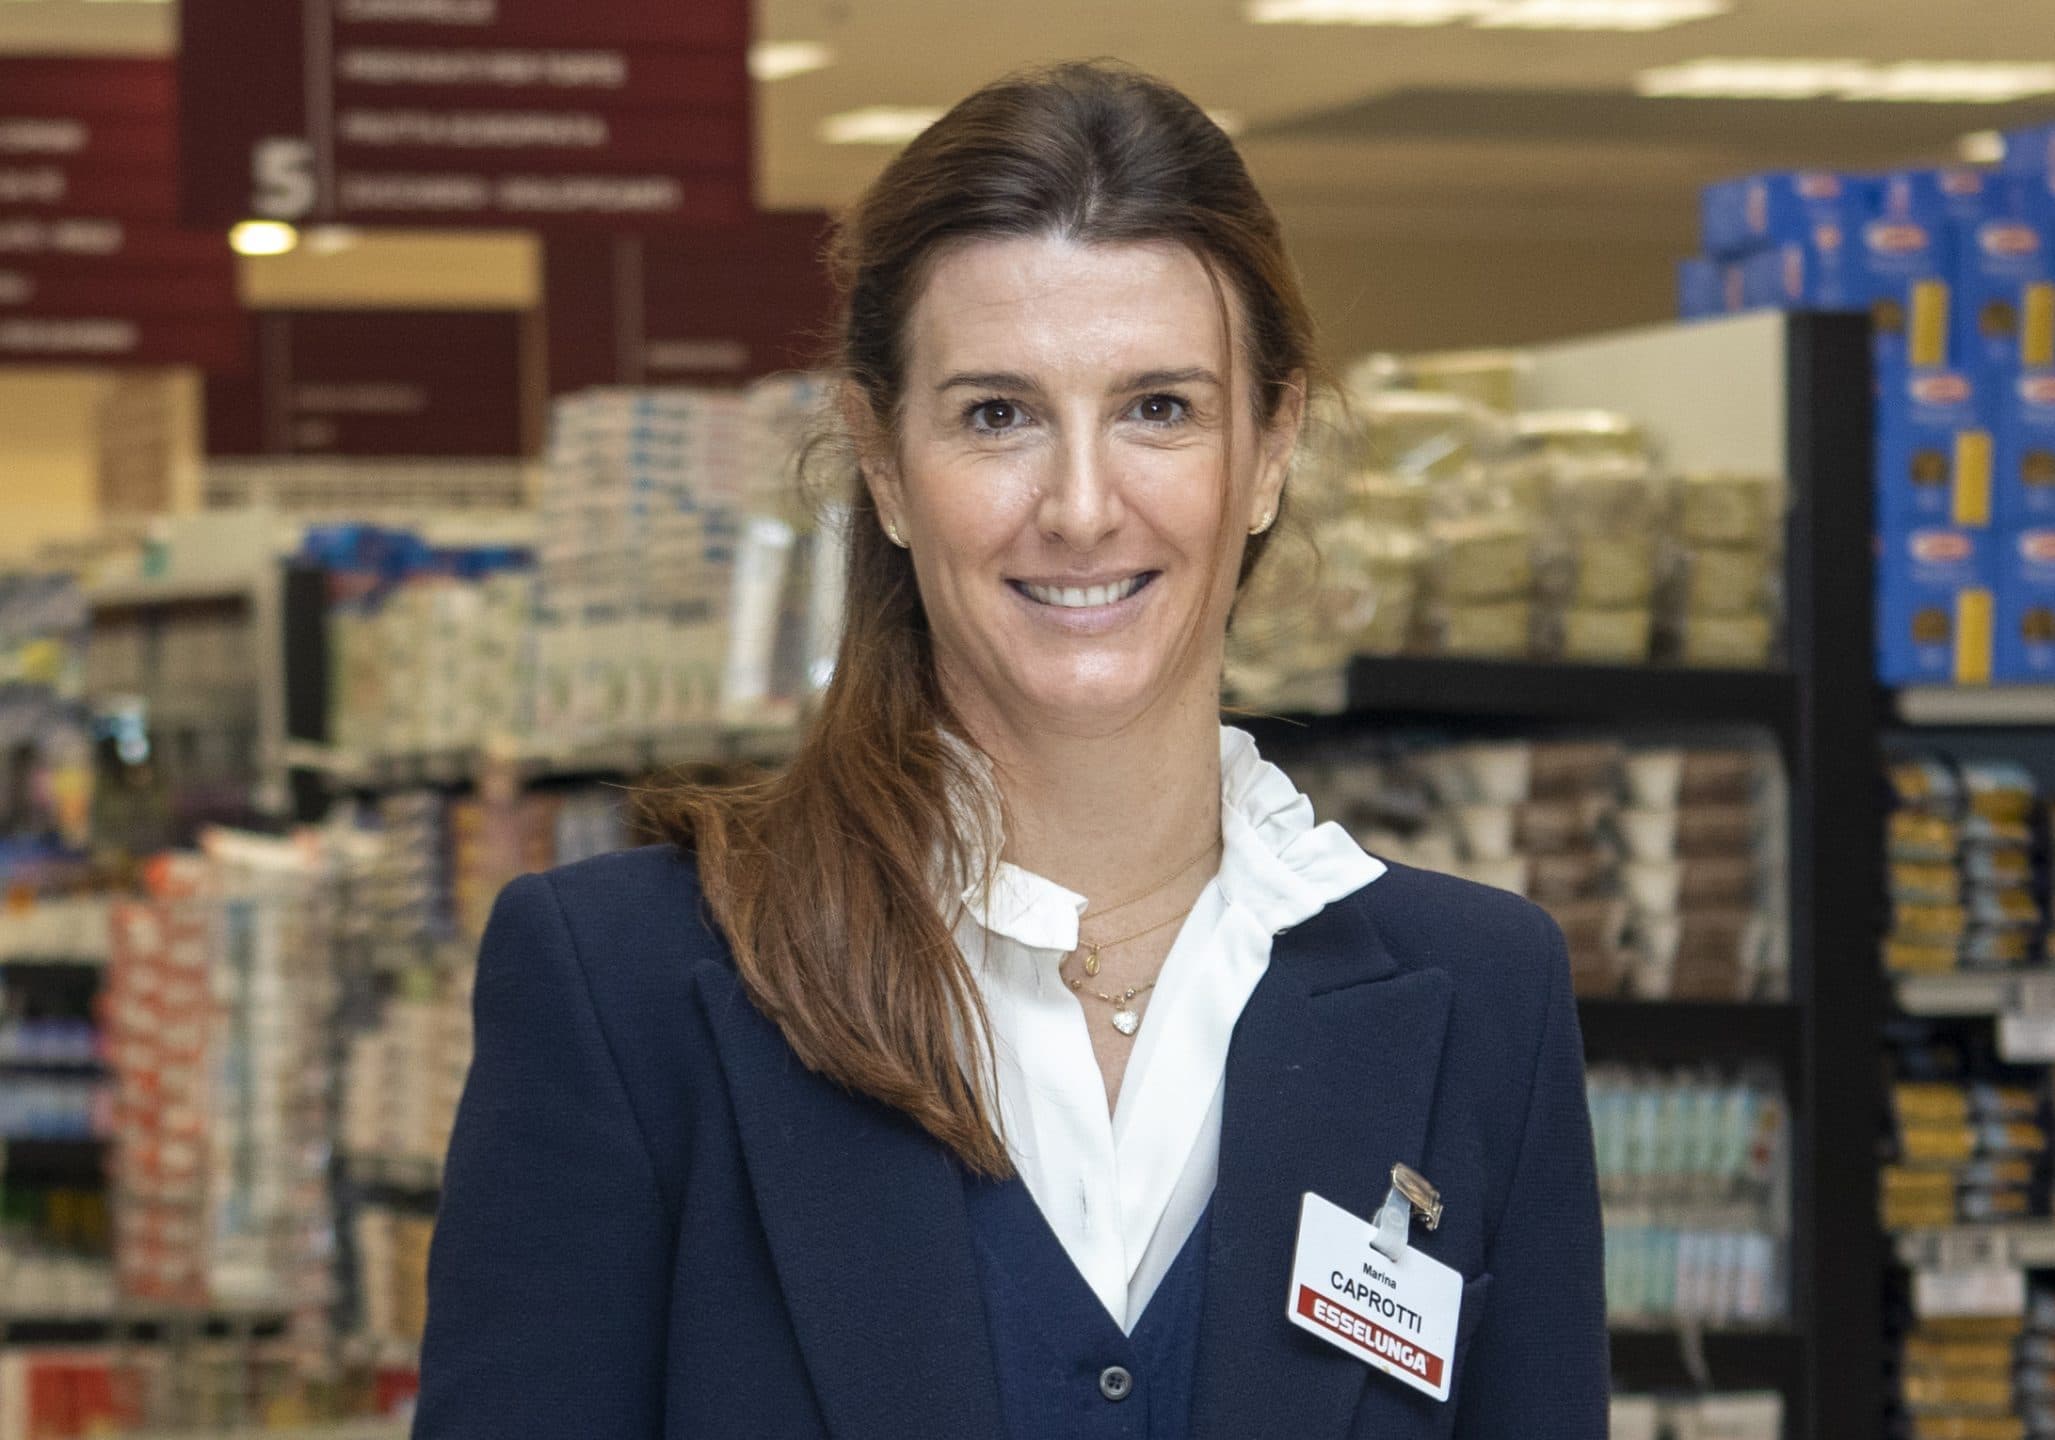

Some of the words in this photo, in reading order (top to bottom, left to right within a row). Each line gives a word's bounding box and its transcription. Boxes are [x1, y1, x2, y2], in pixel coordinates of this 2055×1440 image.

[1330, 1270, 1422, 1334] CAPROTTI
[1362, 1262, 1397, 1290] Marina
[1313, 1298, 1428, 1376] ESSELUNGA
